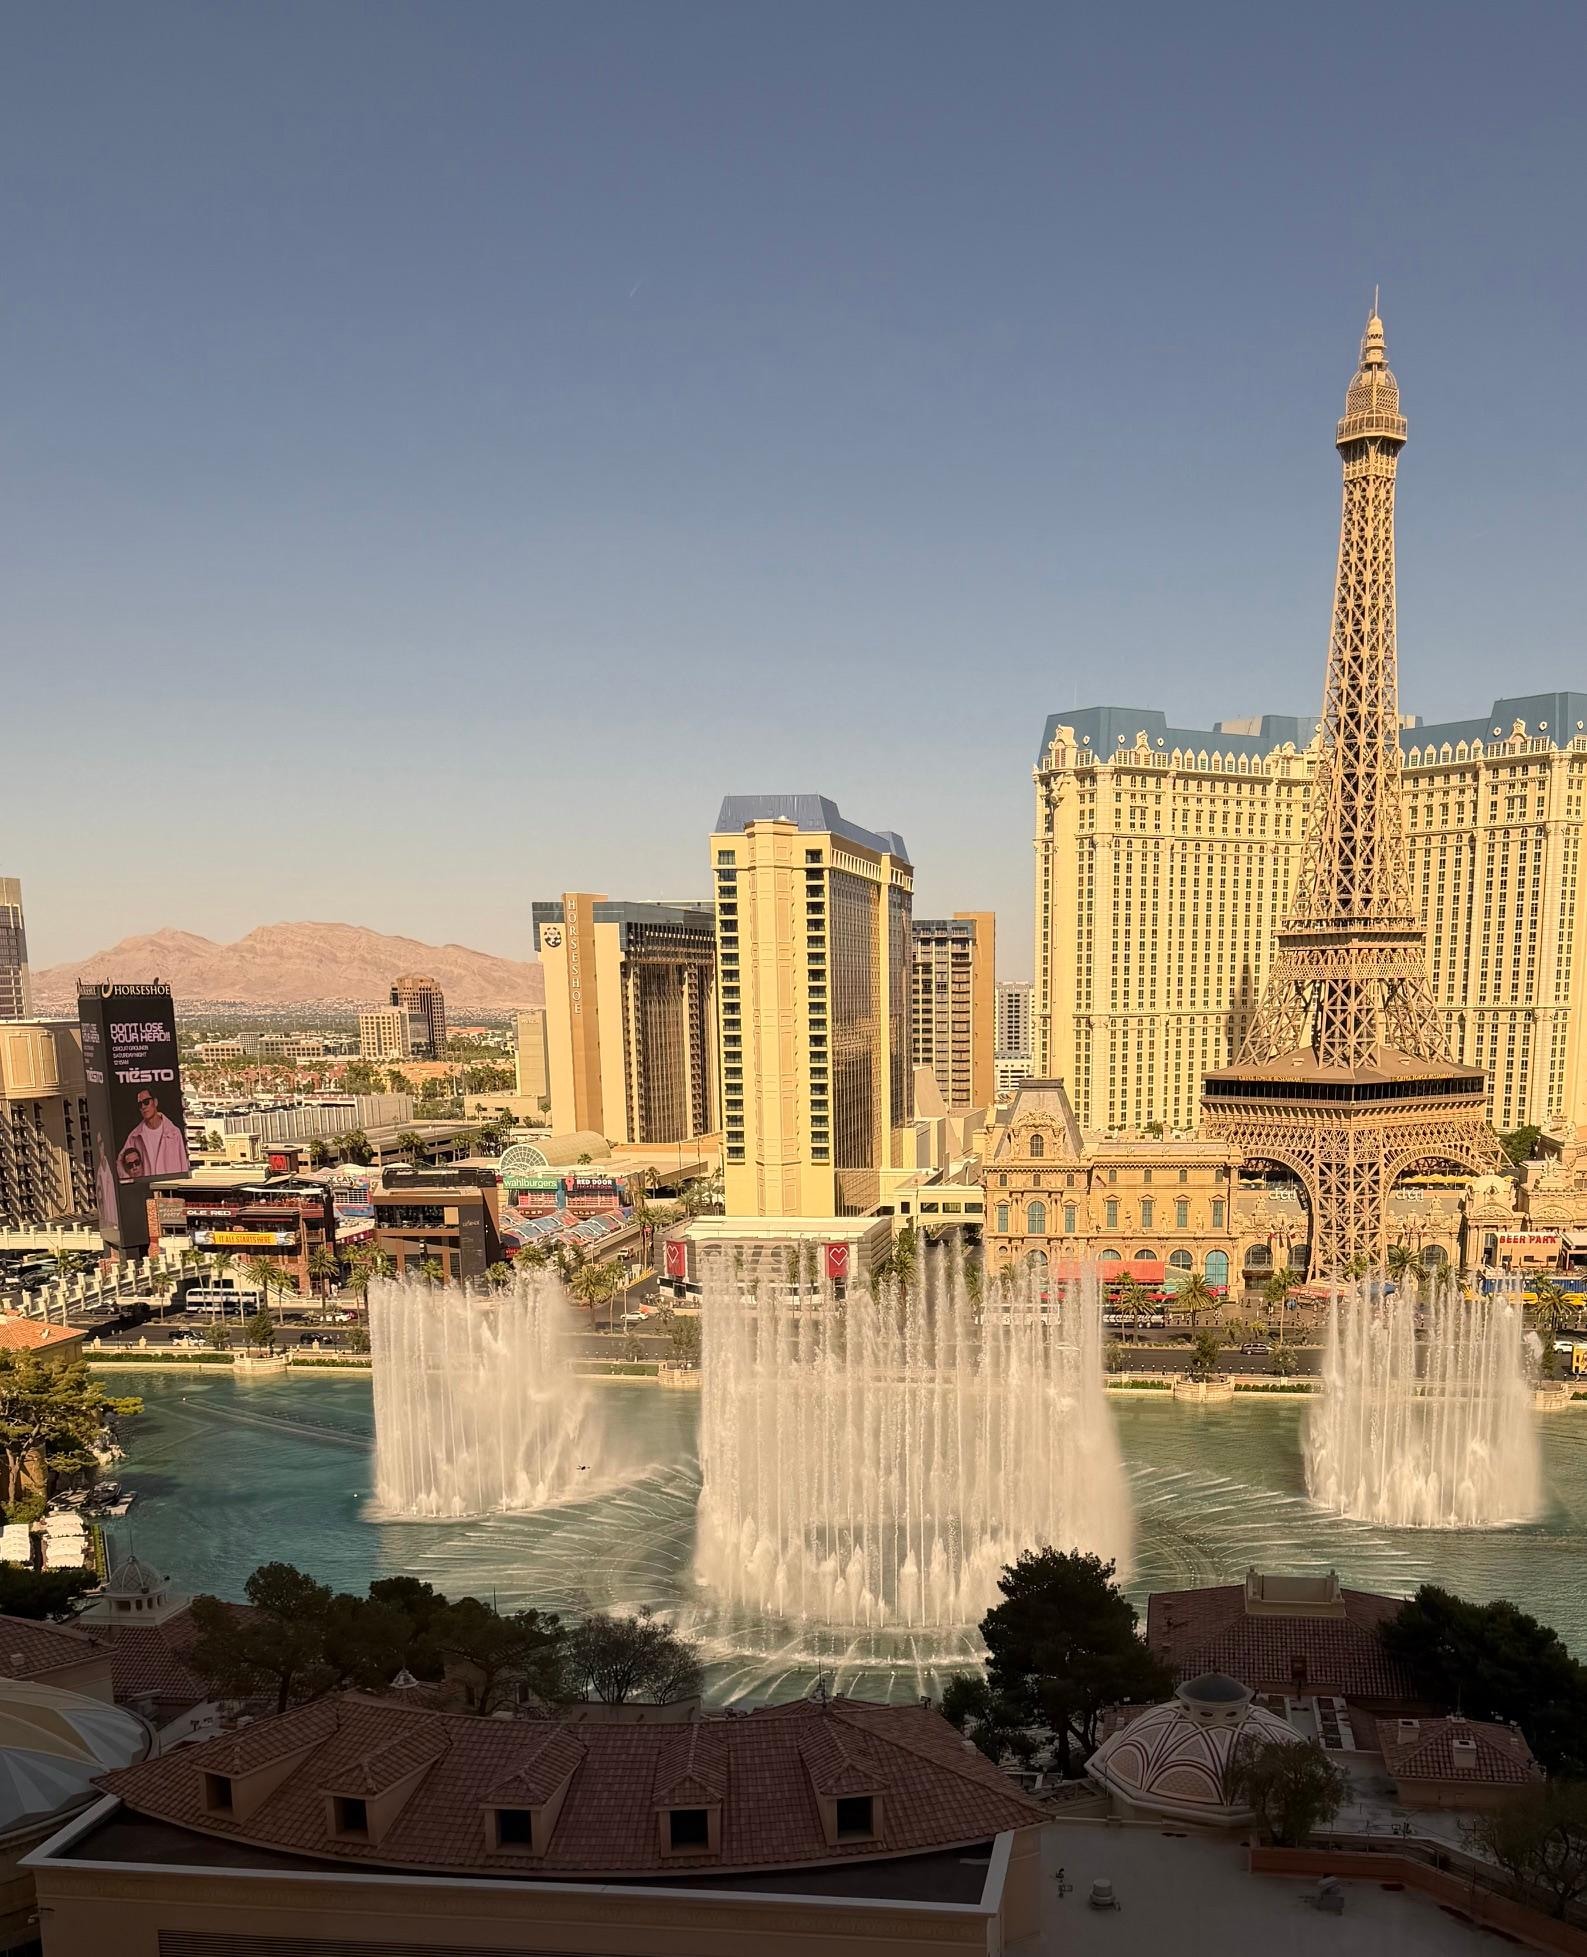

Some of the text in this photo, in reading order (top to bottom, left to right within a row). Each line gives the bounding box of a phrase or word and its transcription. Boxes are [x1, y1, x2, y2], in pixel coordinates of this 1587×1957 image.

[567, 900, 582, 1014] HORSESHOE
[114, 985, 170, 995] HORSESHOE
[140, 1022, 164, 1032] LOSE
[111, 1032, 139, 1043] YOUR
[504, 1178, 557, 1188] wahlburgers
[1500, 1235, 1557, 1244] BEER PARK
